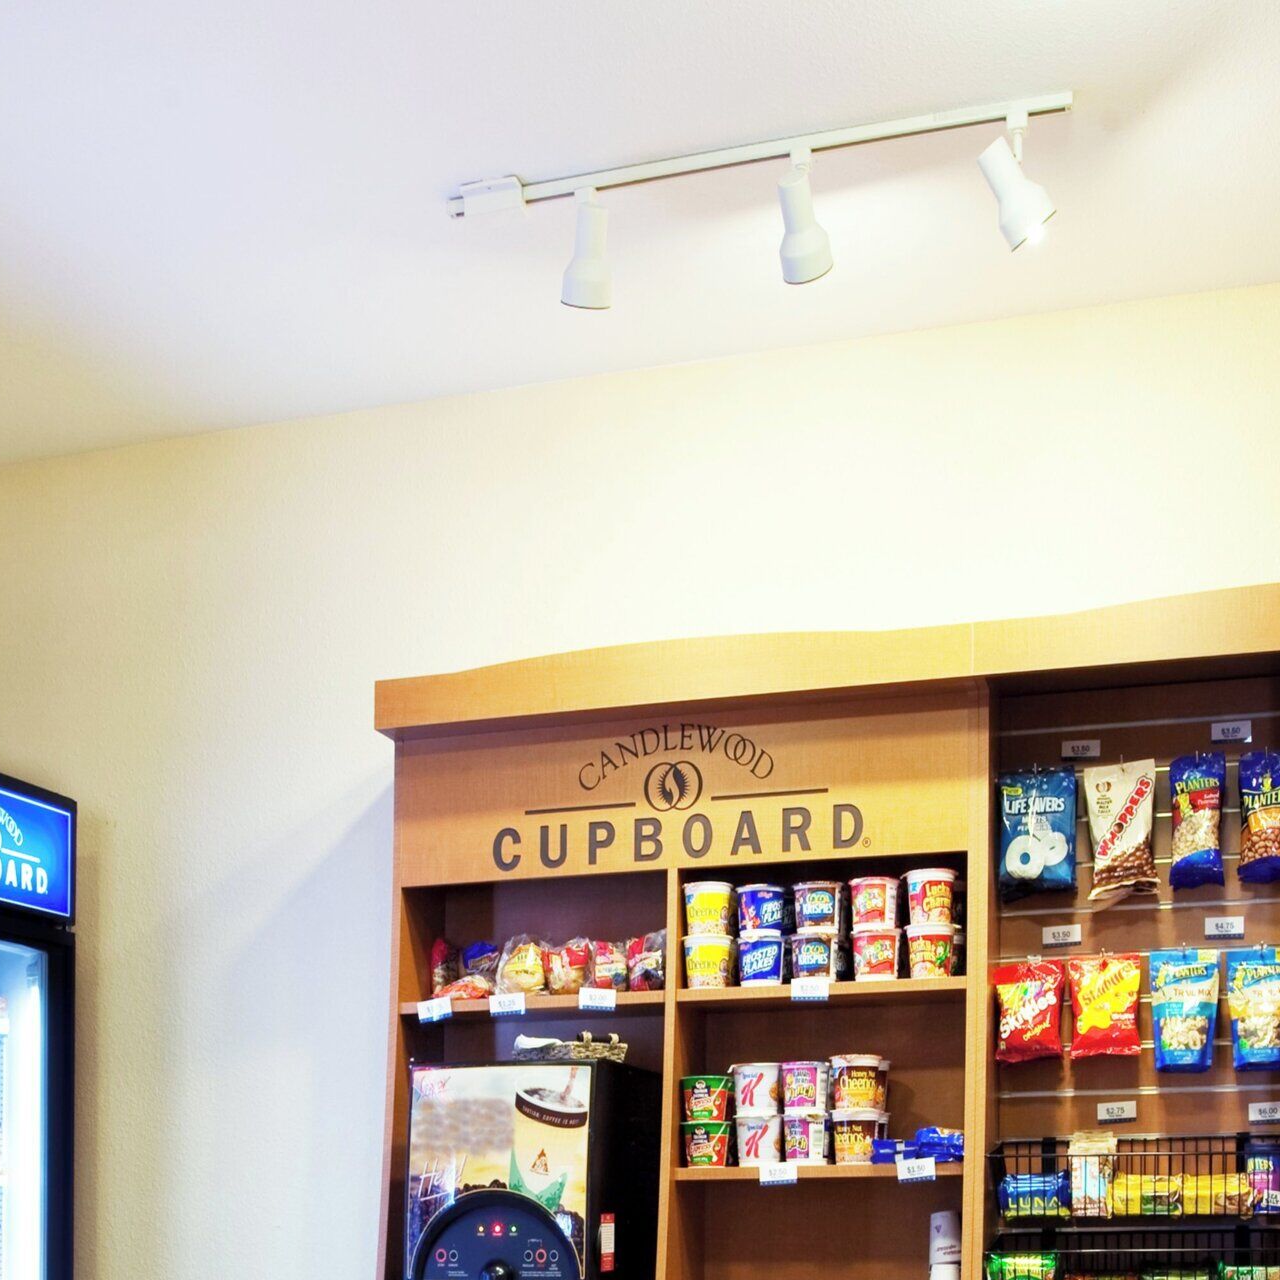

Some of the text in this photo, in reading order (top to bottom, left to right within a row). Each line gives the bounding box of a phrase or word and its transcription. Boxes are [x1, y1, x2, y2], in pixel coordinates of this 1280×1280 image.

[578, 722, 775, 791] CANDLEWOOD
[1174, 777, 1220, 794] PLANTERS
[1006, 796, 1065, 815] LIFE SAVERS
[1096, 777, 1153, 858] WHOPPERS
[493, 803, 865, 872] CUPBOARD
[802, 902, 833, 915] KRISPIES
[1214, 921, 1235, 931] $4.75
[1051, 930, 1071, 940] $3.50
[742, 944, 778, 966] FROSTED
[797, 953, 829, 966] KRISPIES
[743, 956, 775, 977] FLAKES
[1198, 987, 1212, 997] MIX
[740, 1073, 764, 1107] K
[1105, 1106, 1126, 1116] $2.75
[1258, 1106, 1279, 1116] $6.00
[745, 1124, 769, 1158] K
[906, 1163, 926, 1174] $1.50
[1007, 1196, 1061, 1209] LUNA
